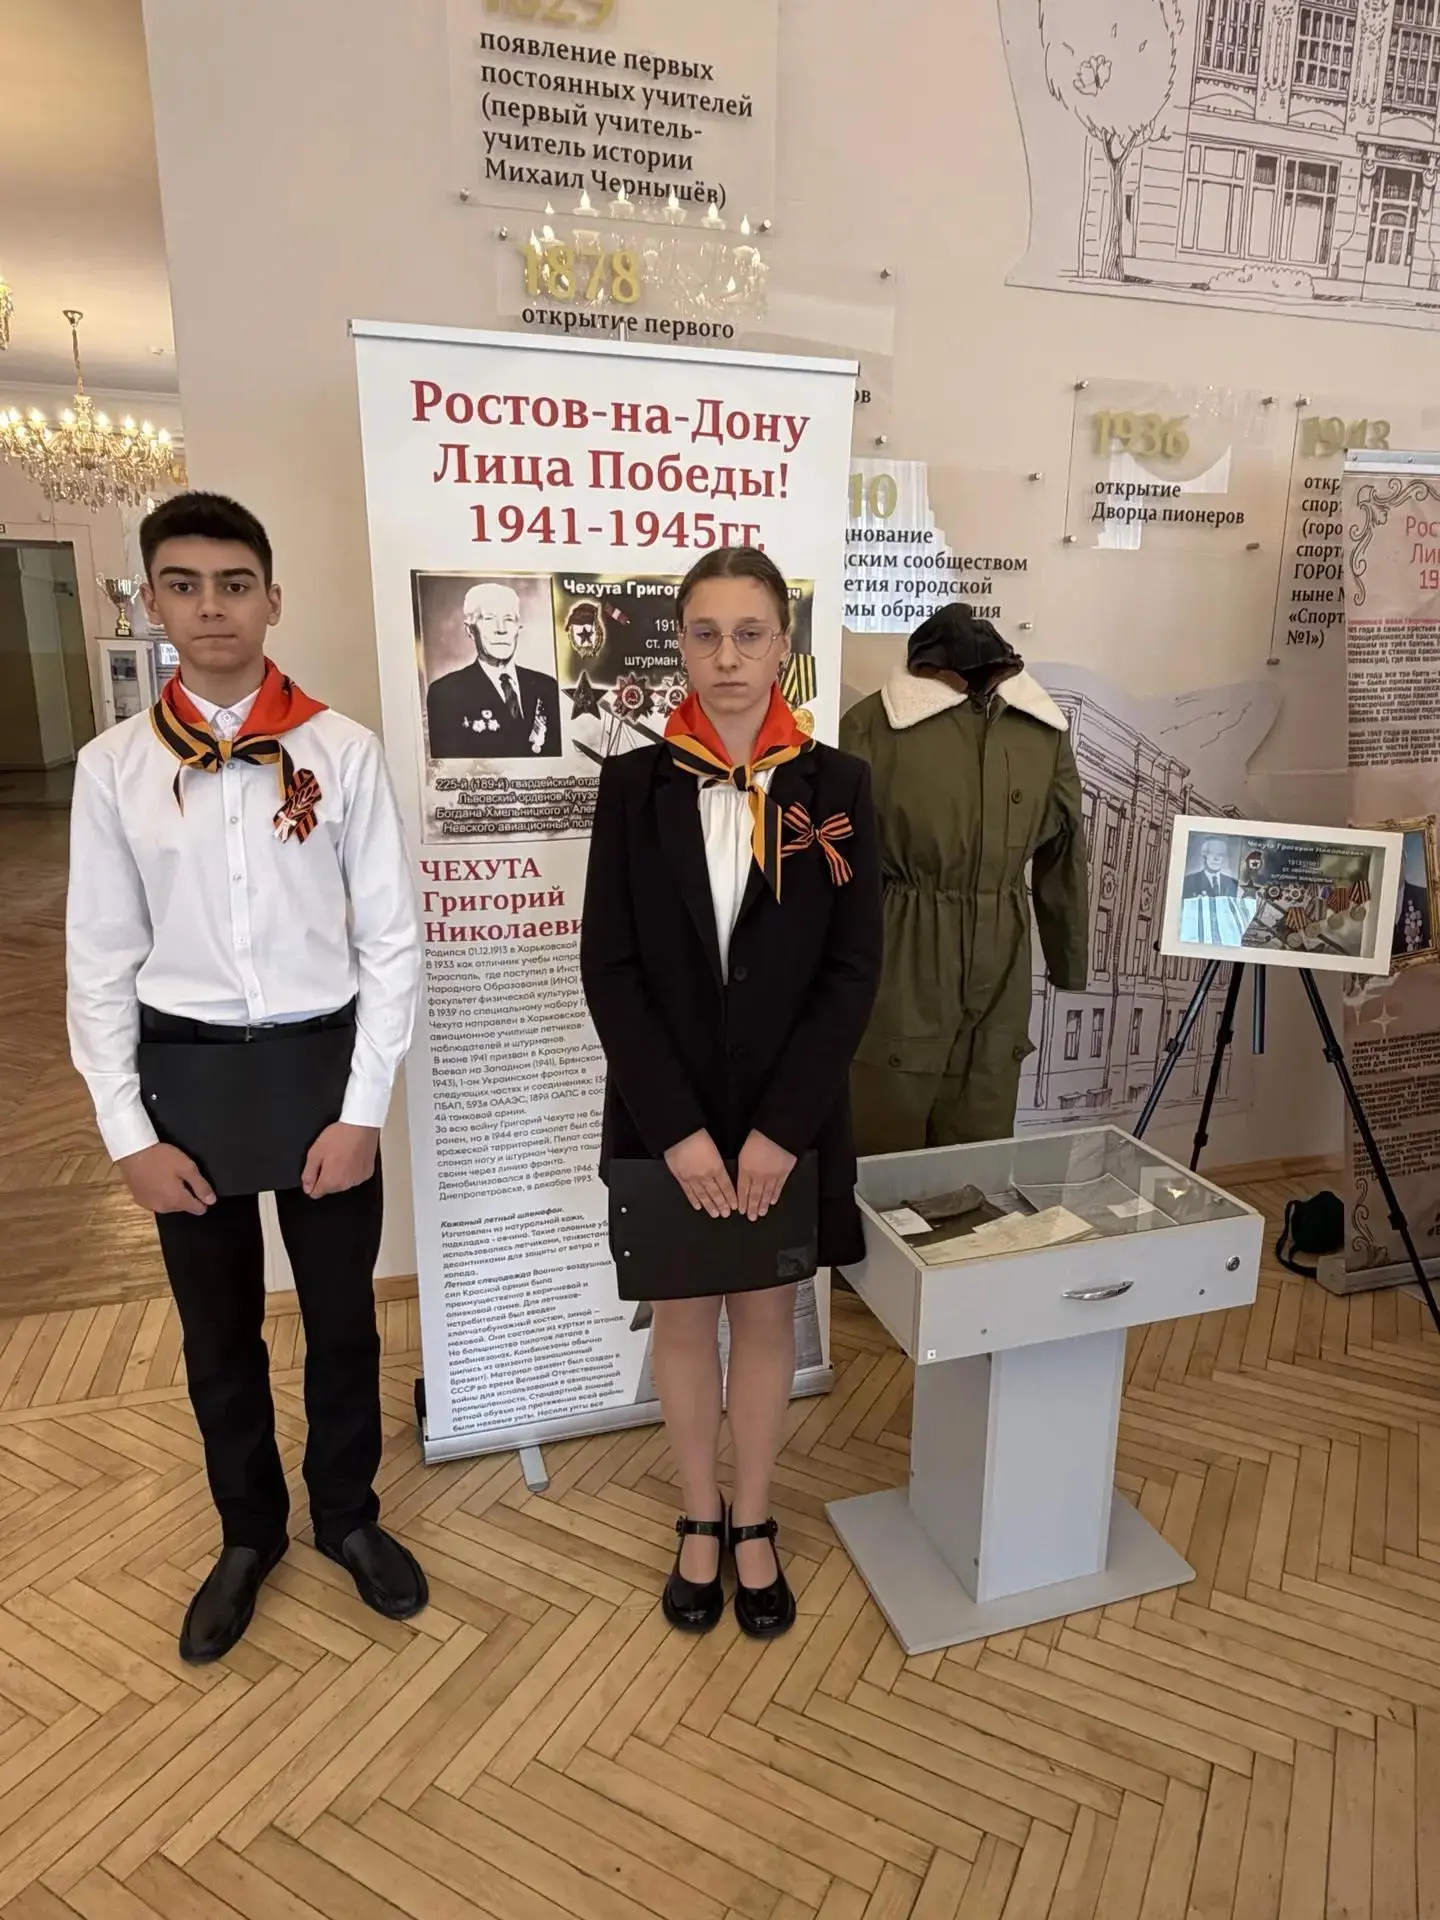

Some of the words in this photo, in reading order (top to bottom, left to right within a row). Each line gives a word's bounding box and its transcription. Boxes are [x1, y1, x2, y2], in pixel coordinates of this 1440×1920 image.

[480, 32, 616, 67] появление
[624, 51, 714, 81] первых
[481, 64, 636, 101] постоянных
[642, 85, 752, 118] учителей
[482, 93, 588, 128] (первый
[594, 111, 703, 140] учитель-
[483, 129, 586, 160] учитель
[592, 142, 693, 172] истории
[485, 158, 584, 190] Михаил
[591, 171, 726, 208] Чернышёв)
[521, 244, 641, 304] 1878
[522, 306, 638, 332] открытие
[644, 317, 734, 340] первого
[410, 380, 810, 452] Ростов-на-Дону
[1093, 411, 1190, 458] 1936
[434, 443, 574, 490] Лица
[588, 450, 788, 500] Победы!
[1095, 480, 1182, 498] открытие
[1092, 502, 1158, 524] Дворца
[1162, 508, 1244, 528] пионеров
[470, 504, 766, 552] 1941-1945гг.
[845, 528, 933, 544] нование
[1302, 518, 1343, 539] (горо
[1406, 516, 1440, 537] Рос
[844, 553, 898, 570] ским
[904, 552, 1028, 572] сообществом
[564, 580, 622, 596] Чехута
[894, 578, 993, 598] городской
[1292, 590, 1334, 602] ныне
[654, 619, 680, 632] 191
[646, 640, 660, 649] ст.
[1287, 629, 1324, 648] №1»)
[624, 656, 678, 672] штурман
[436, 778, 468, 790] 225-й
[470, 776, 510, 792] (189-й)
[511, 776, 576, 790] гвардейский
[458, 792, 516, 805] Львовский
[518, 793, 562, 804] орденов
[564, 790, 599, 802] Кутузо
[436, 807, 482, 819] Богдана
[485, 805, 560, 818] Хмельницкого
[563, 806, 570, 814] и
[443, 821, 495, 834] Невского
[498, 820, 570, 833] авиационный
[420, 857, 542, 882] ЧЕХУТА
[422, 884, 566, 918] Григорий
